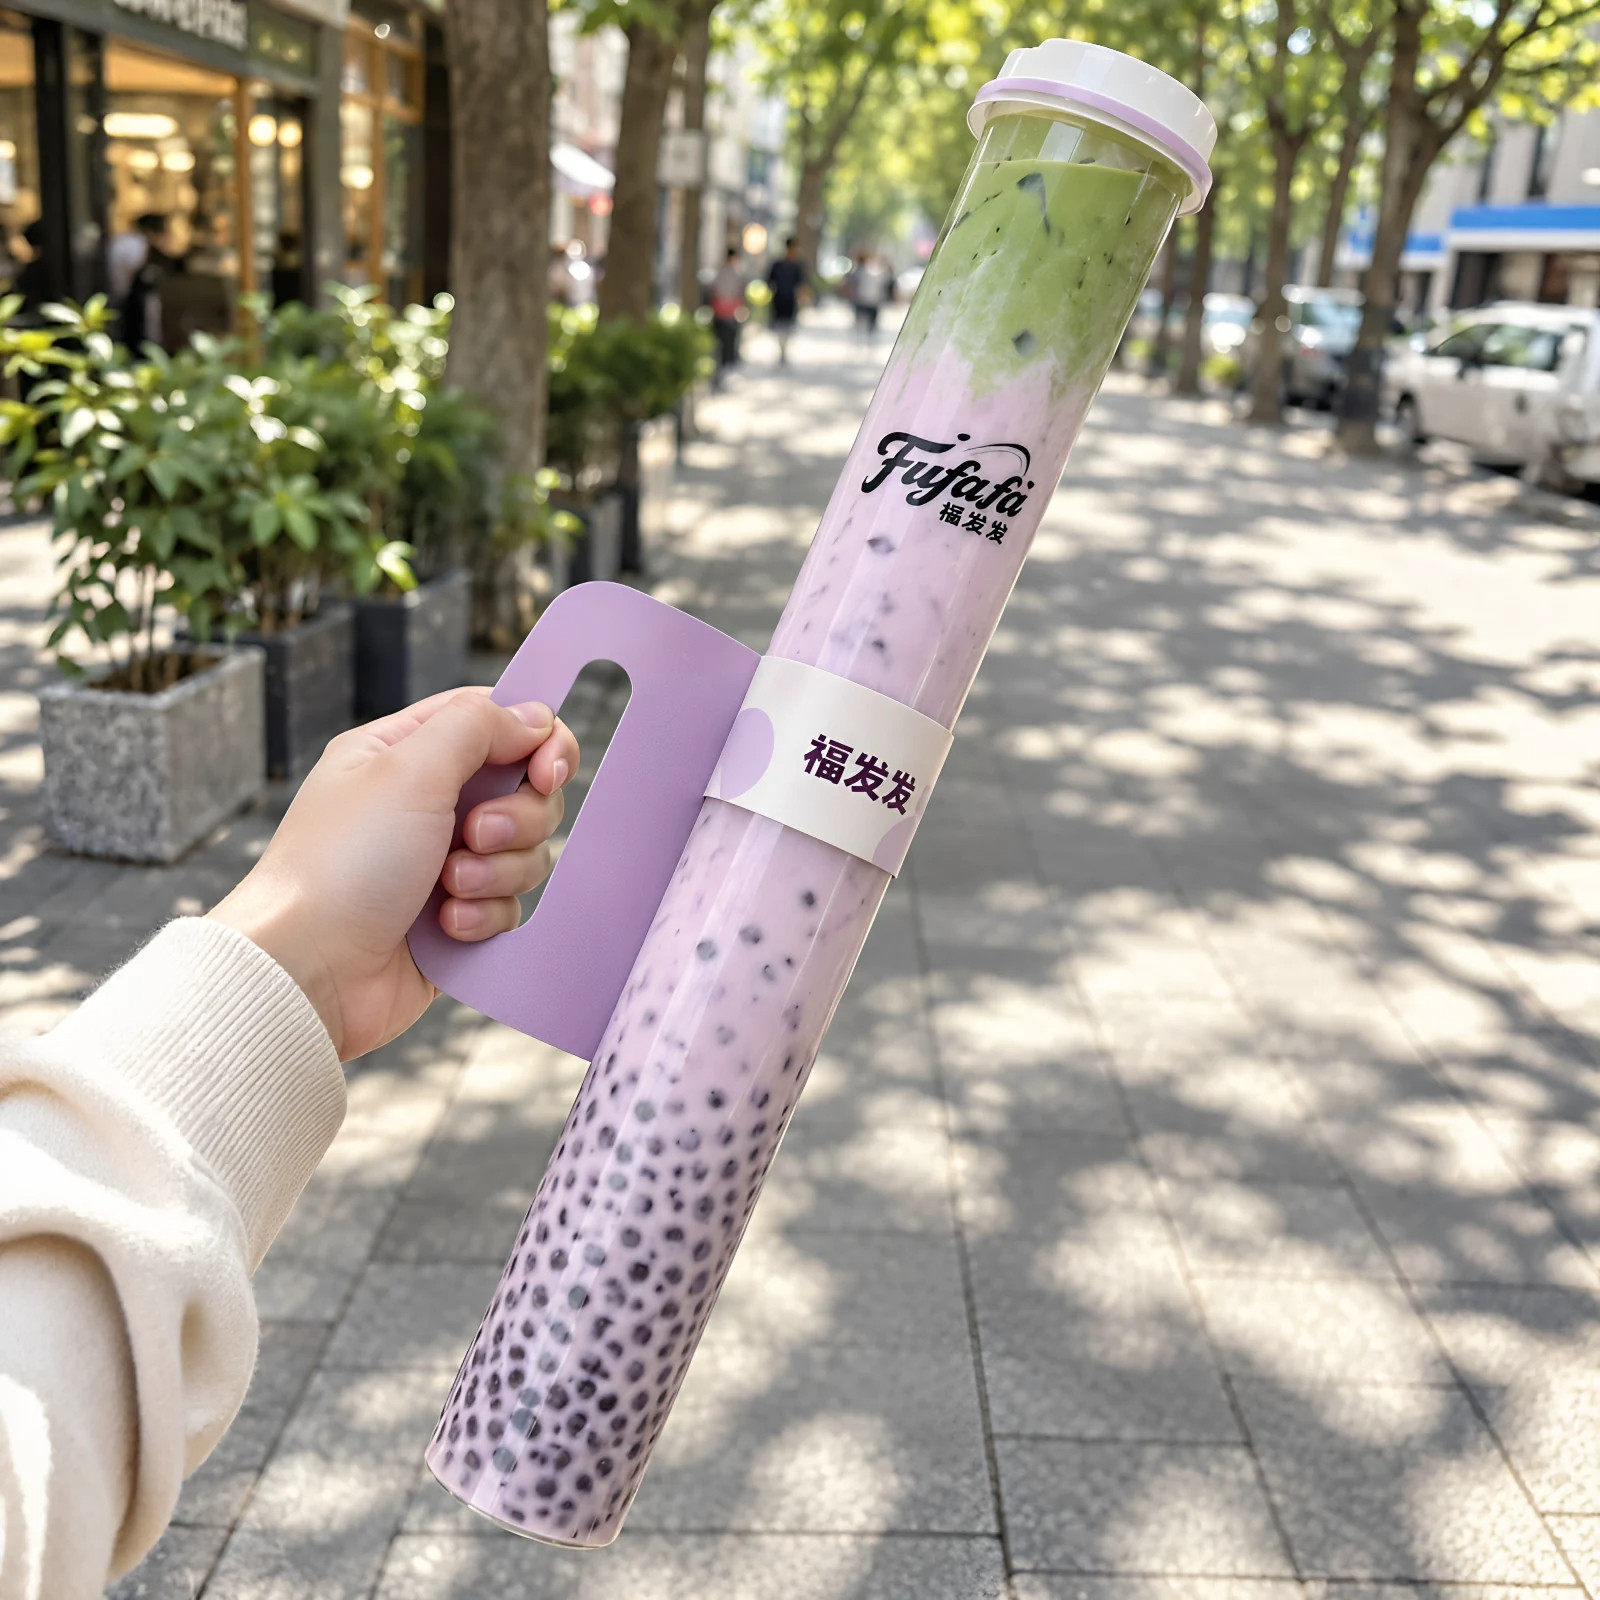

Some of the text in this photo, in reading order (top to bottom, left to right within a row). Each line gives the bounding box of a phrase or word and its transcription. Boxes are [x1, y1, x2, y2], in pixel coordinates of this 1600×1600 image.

[939, 502, 1008, 545] 福发发
[803, 733, 916, 816] 福发发
